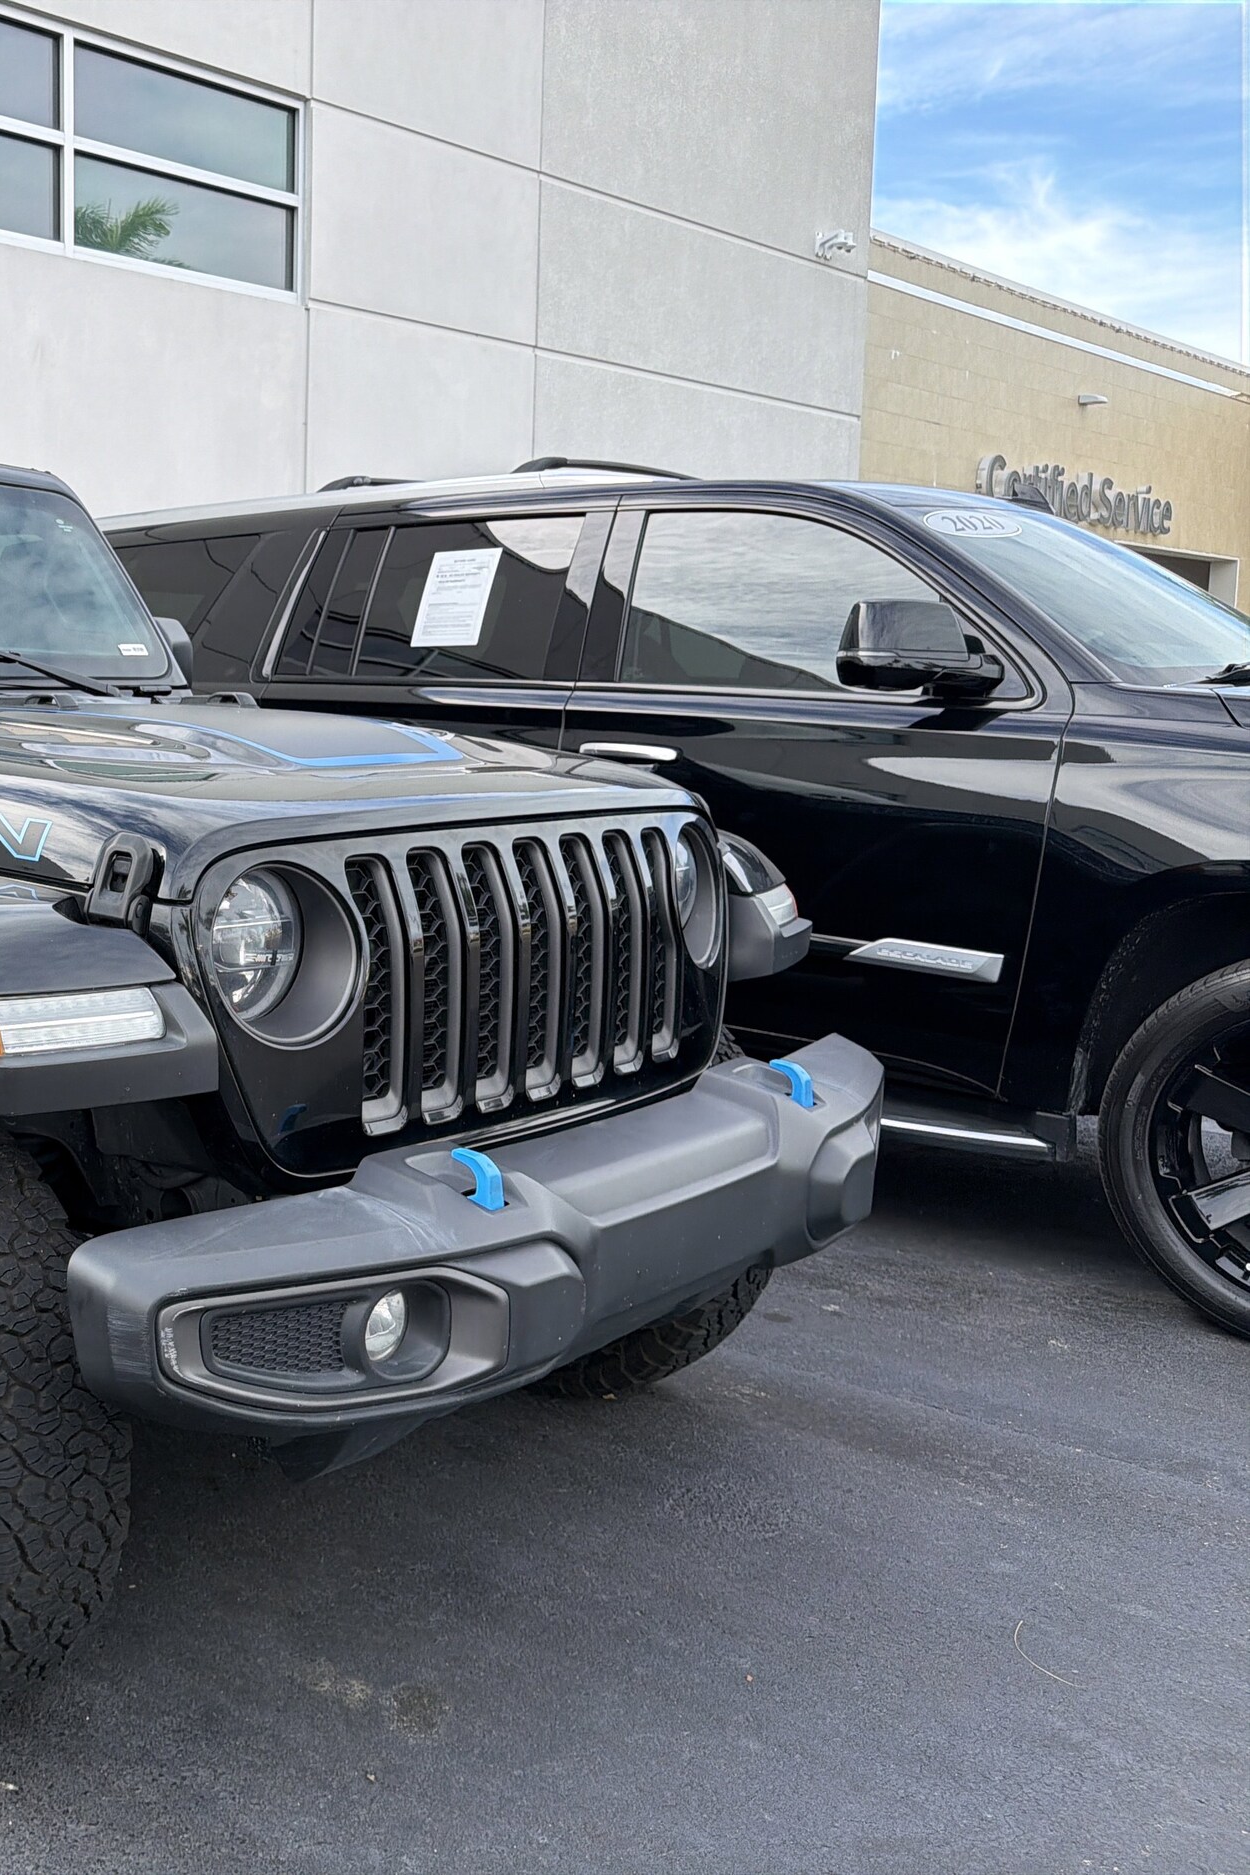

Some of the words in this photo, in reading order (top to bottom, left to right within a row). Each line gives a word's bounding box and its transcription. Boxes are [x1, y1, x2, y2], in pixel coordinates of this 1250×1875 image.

[976, 455, 1094, 522] Certified
[1098, 477, 1173, 535] Service
[941, 515, 1005, 532] 2020
[877, 948, 973, 969] ESCALADE
